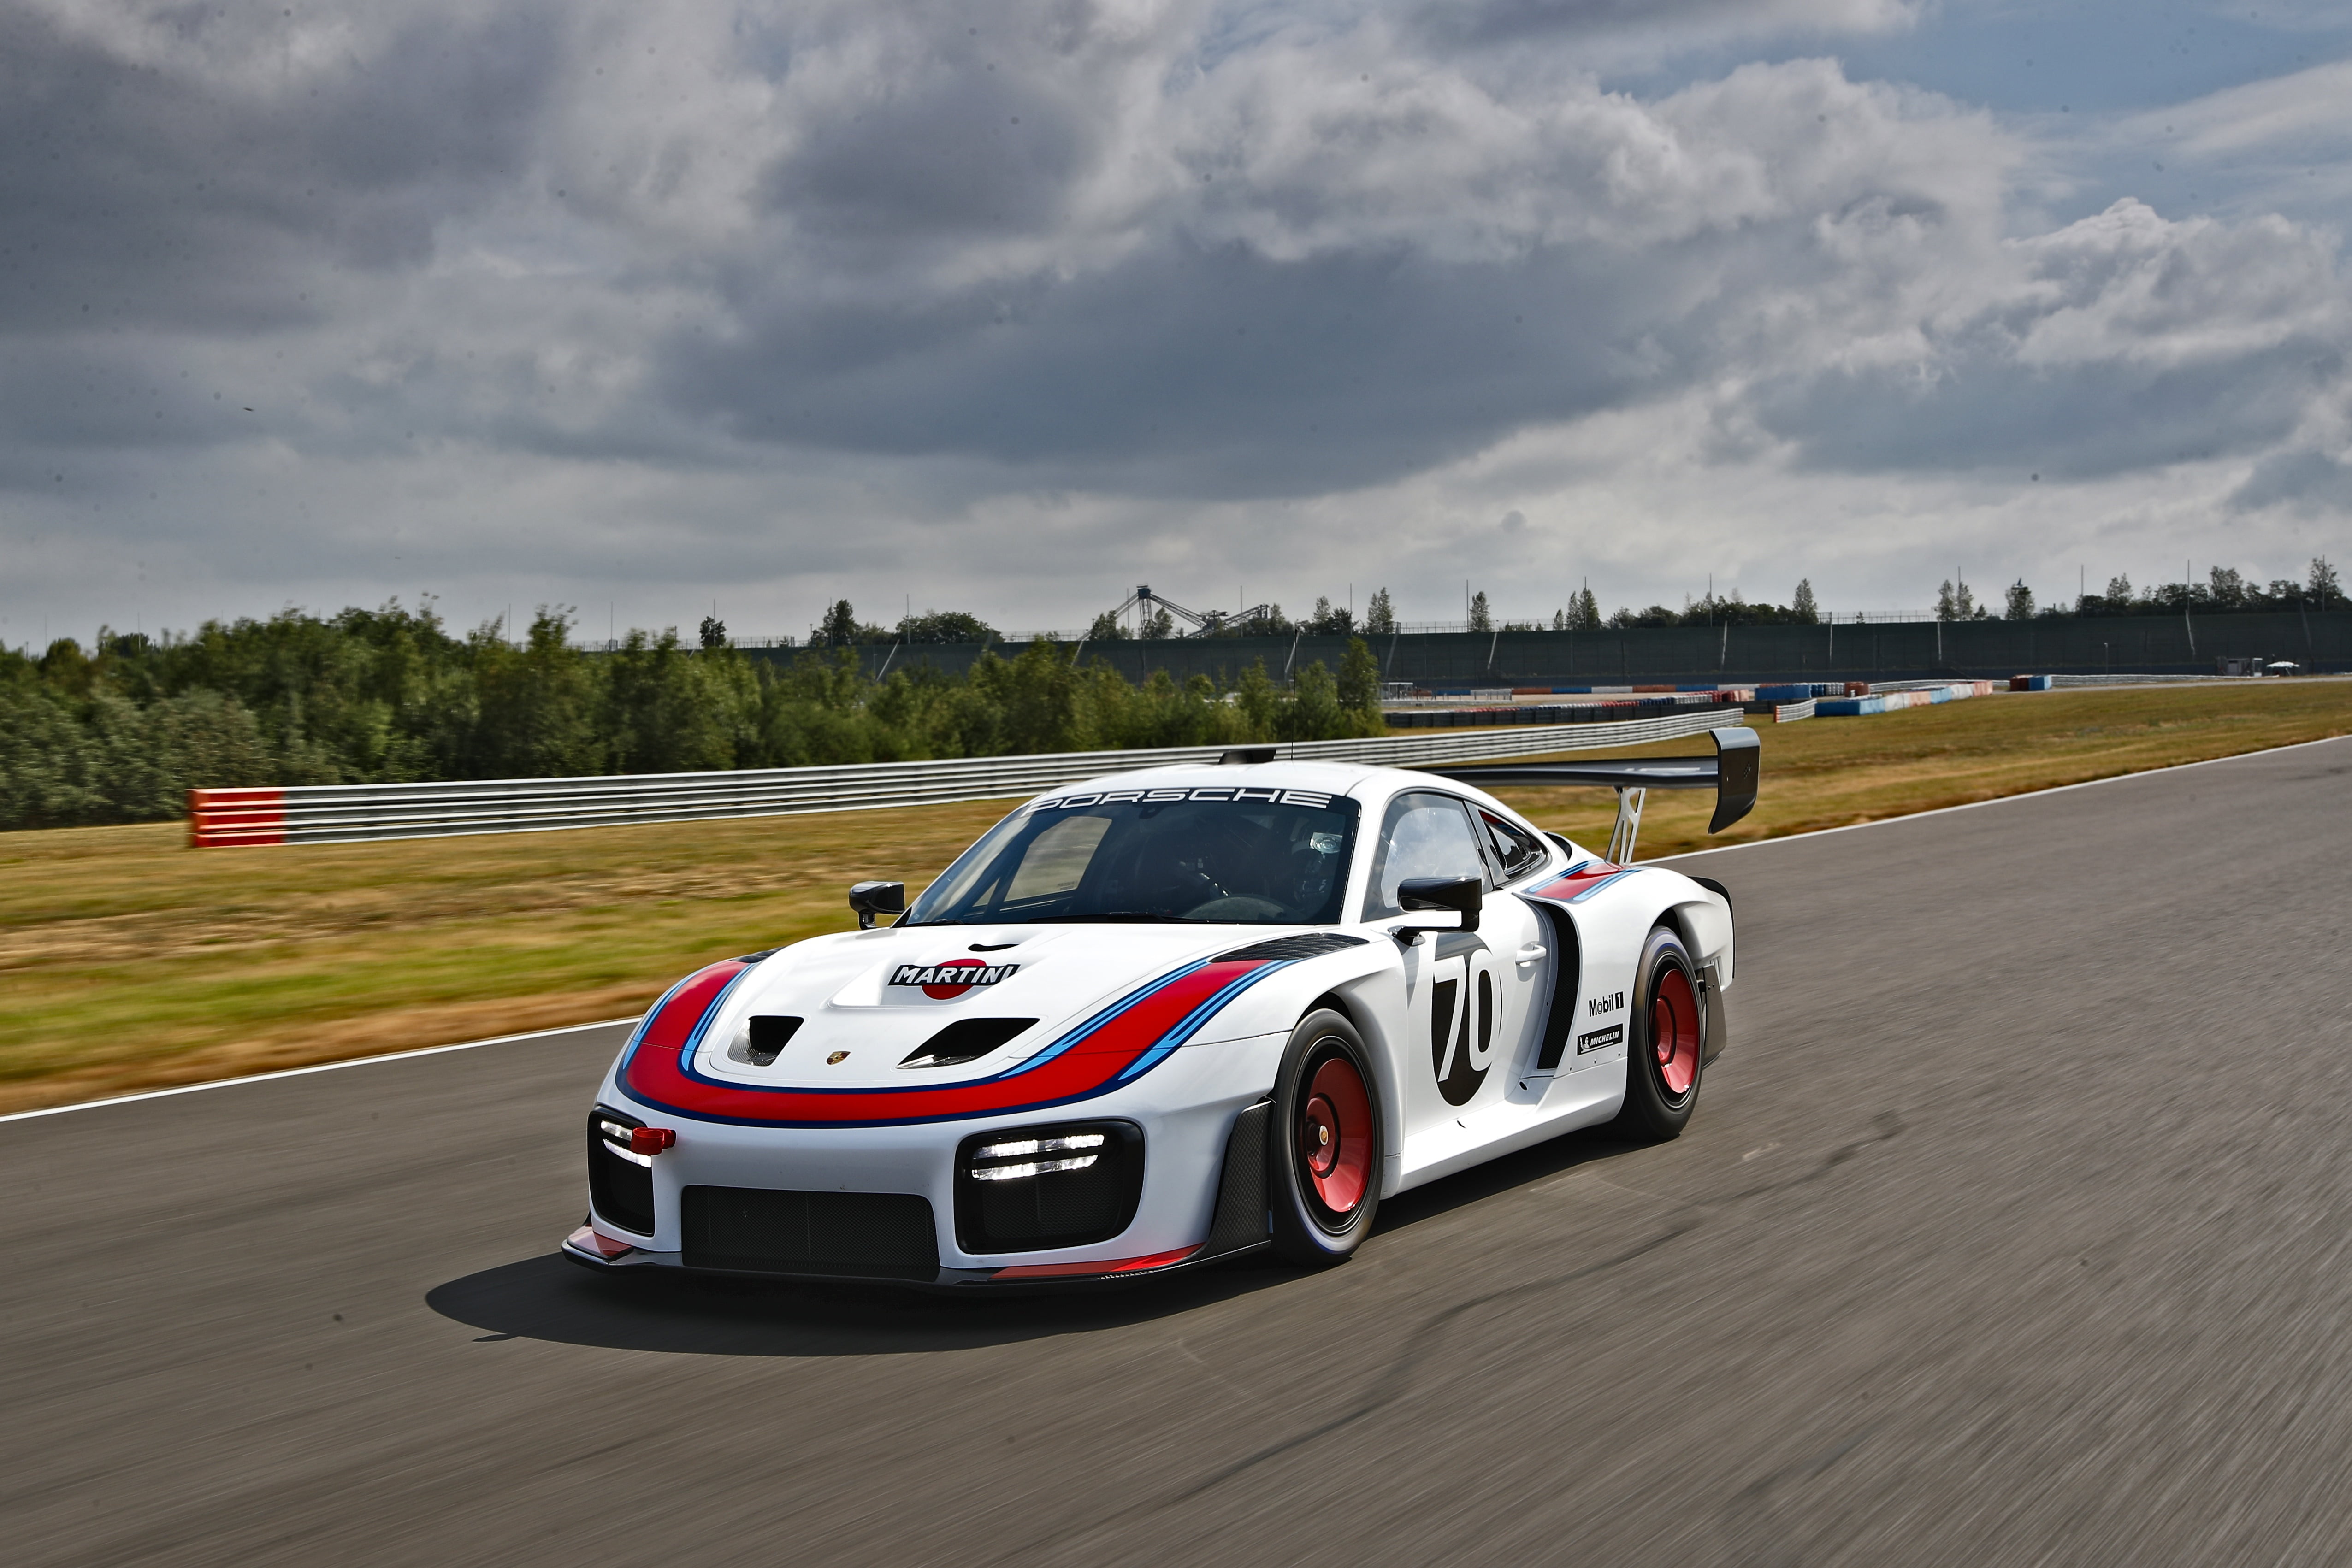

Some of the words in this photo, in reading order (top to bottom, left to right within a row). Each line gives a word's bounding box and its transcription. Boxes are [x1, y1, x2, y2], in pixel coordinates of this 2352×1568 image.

[1020, 789, 1332, 817] PORSCHE
[894, 966, 1014, 984] MARTINI
[1433, 949, 1501, 1083] 70
[1589, 994, 1614, 1017] Mobil
[1590, 1031, 1619, 1046] MICHELIN
